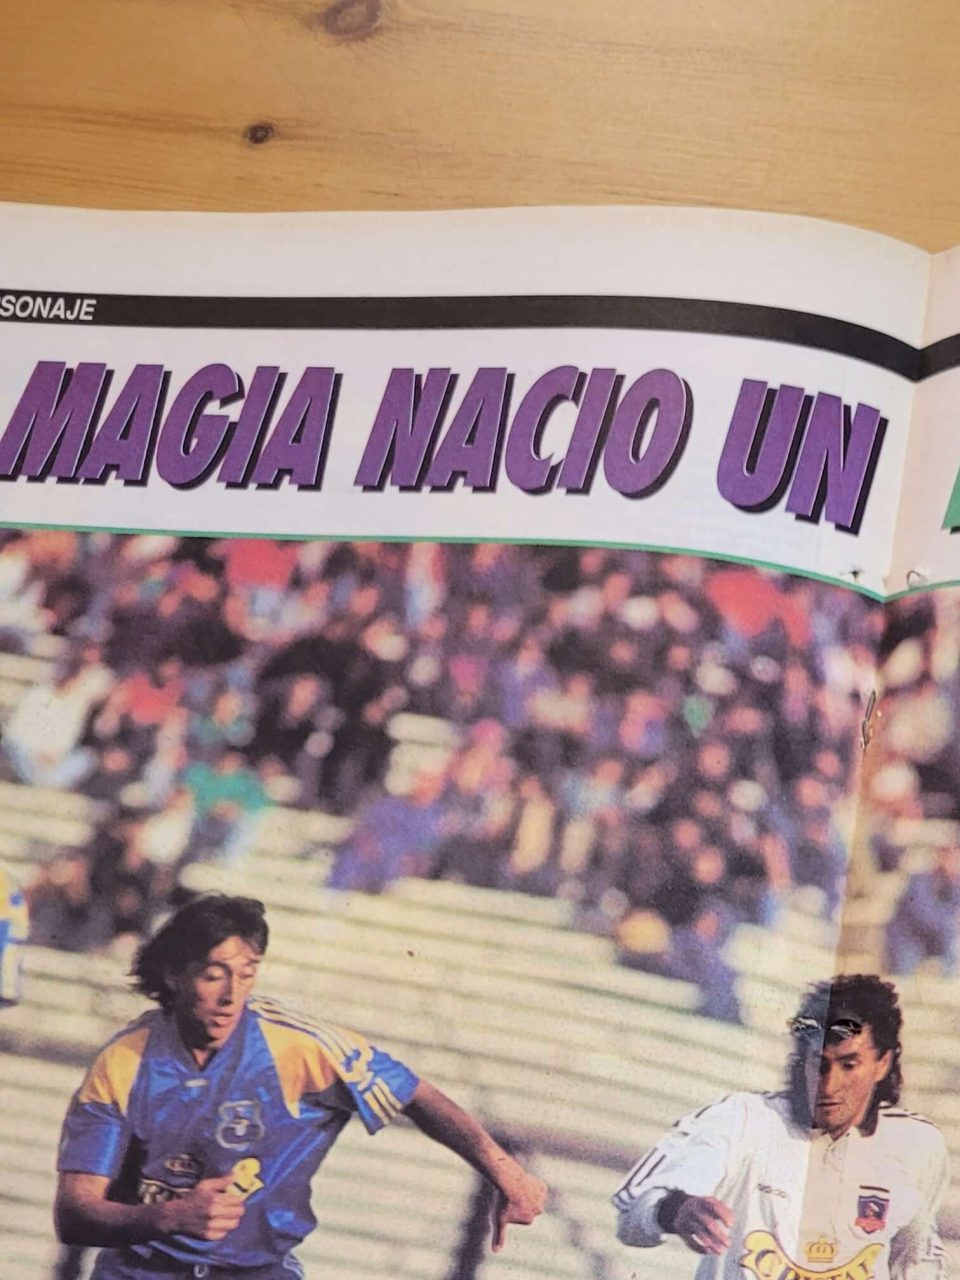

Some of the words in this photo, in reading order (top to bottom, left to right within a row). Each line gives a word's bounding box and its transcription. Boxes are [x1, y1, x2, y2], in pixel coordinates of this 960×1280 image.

[0, 295, 97, 320] SONAJE
[0, 361, 344, 491] MAGIA
[354, 366, 693, 500] NACIO
[716, 378, 888, 535] UN
